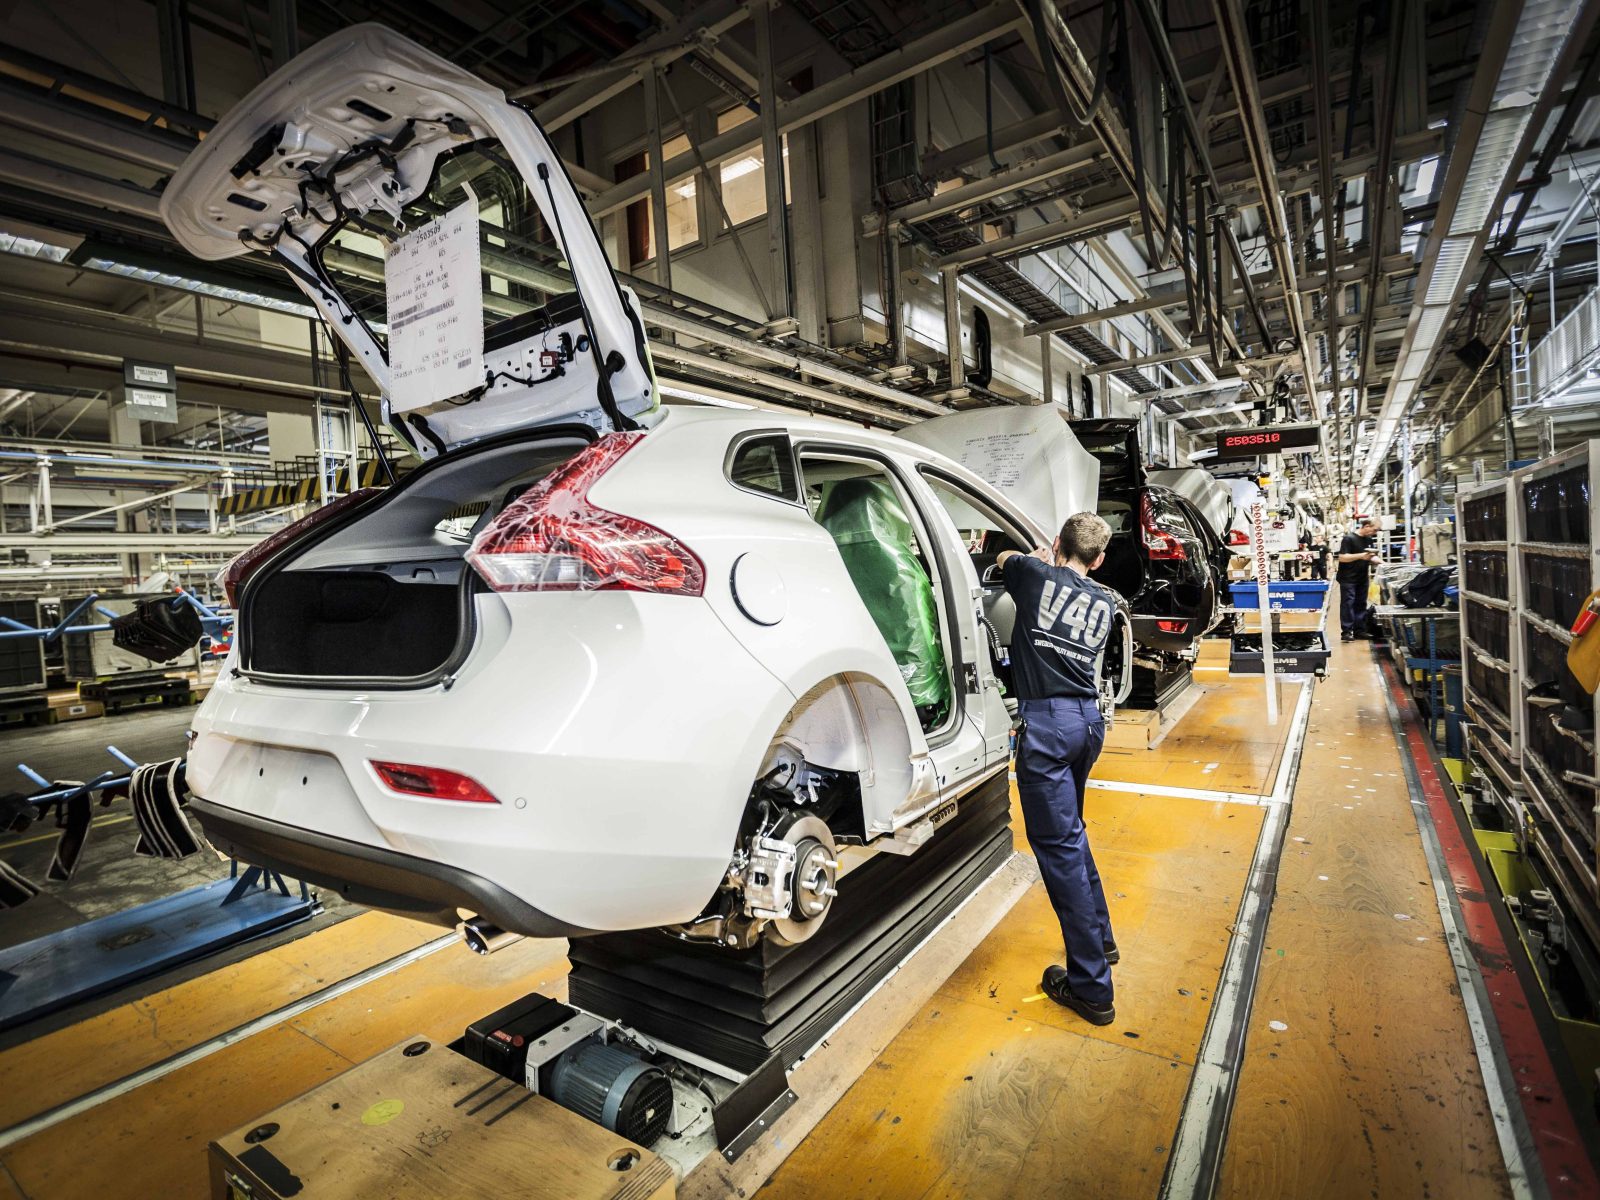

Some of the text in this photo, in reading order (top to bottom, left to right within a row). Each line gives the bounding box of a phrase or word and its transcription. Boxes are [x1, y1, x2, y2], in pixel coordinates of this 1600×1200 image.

[416, 224, 441, 244] 2503509
[1225, 433, 1281, 447] 2503510
[1037, 579, 1111, 648] V40
